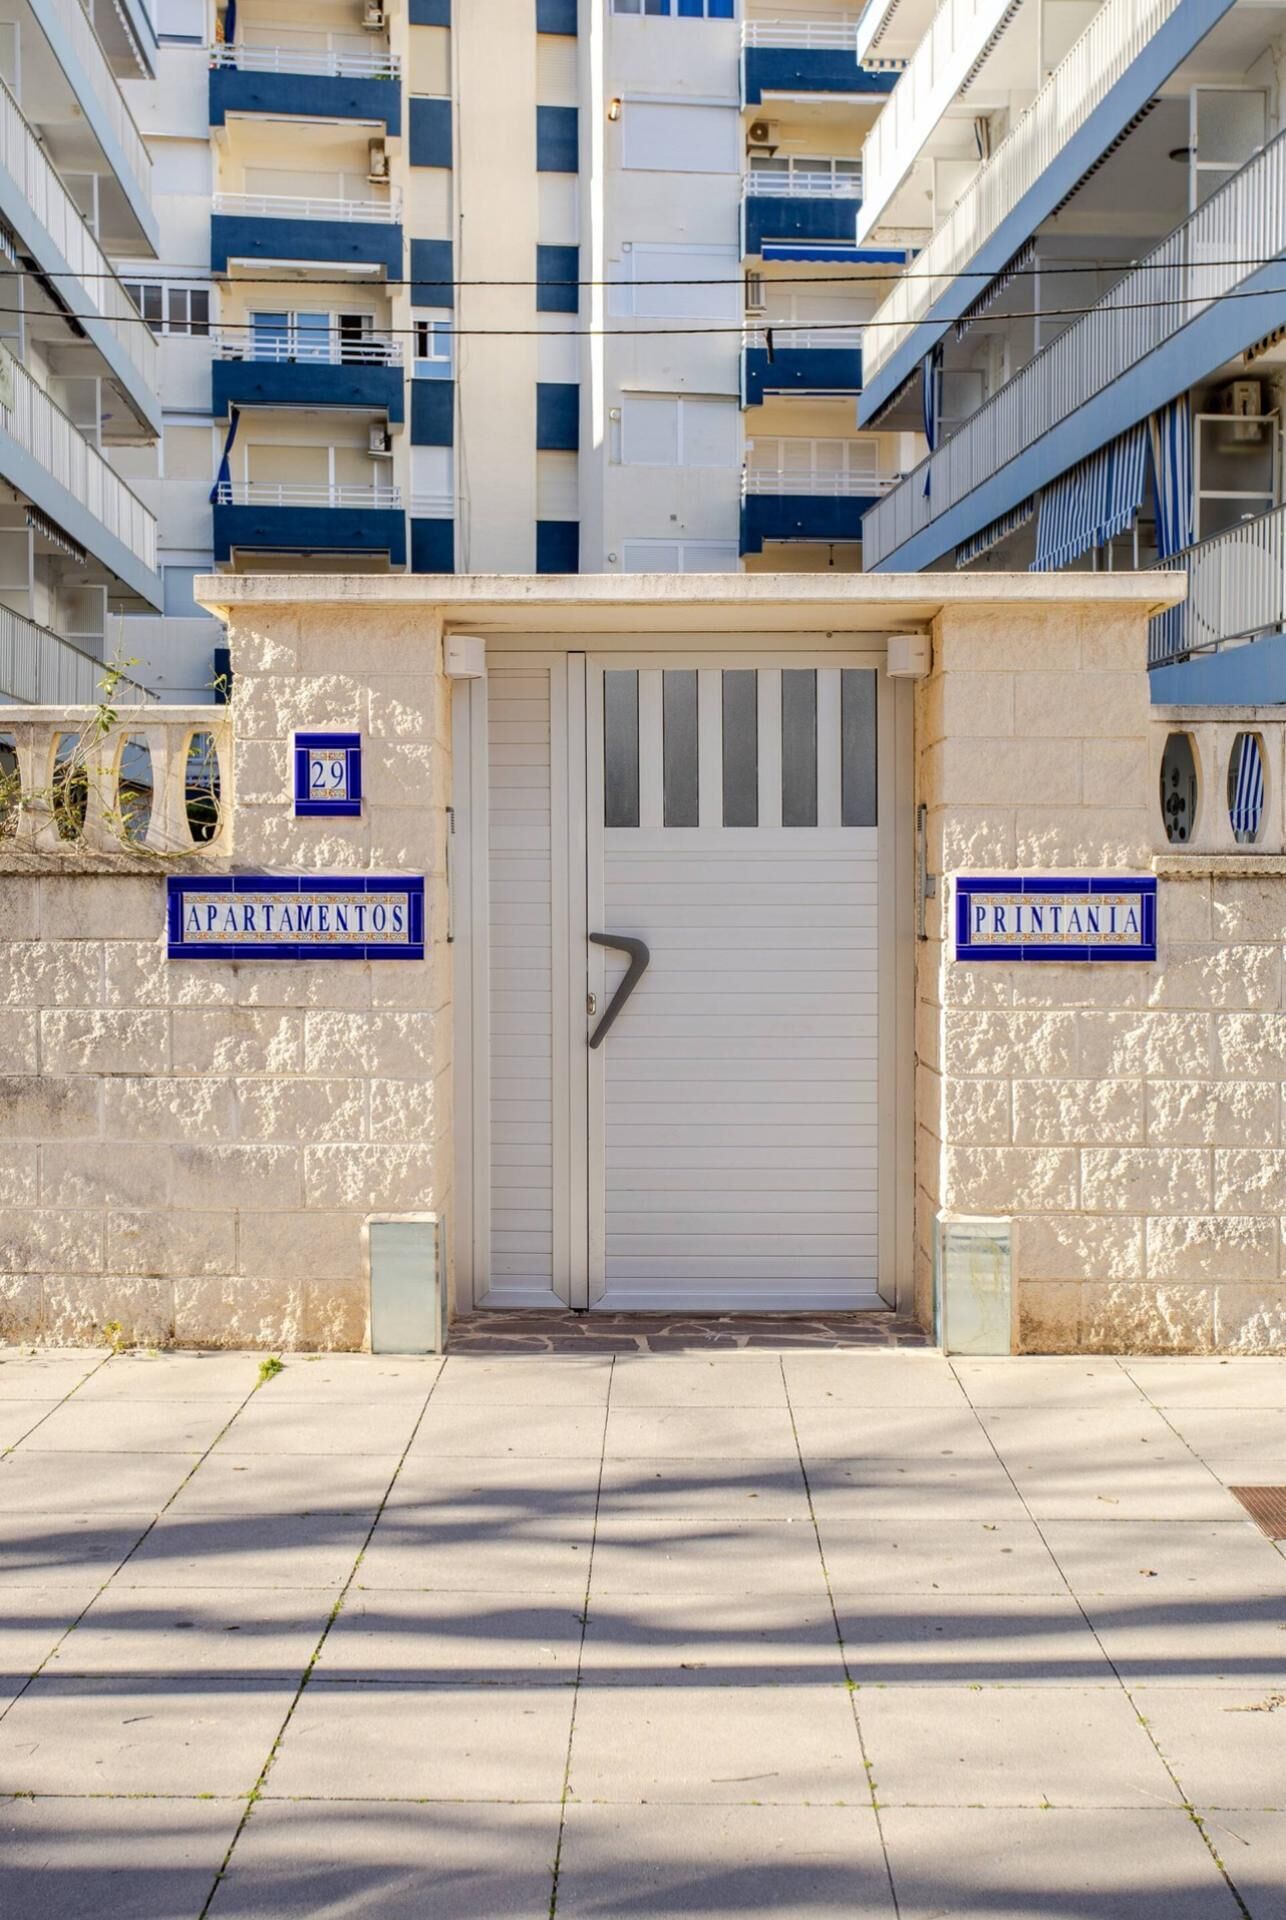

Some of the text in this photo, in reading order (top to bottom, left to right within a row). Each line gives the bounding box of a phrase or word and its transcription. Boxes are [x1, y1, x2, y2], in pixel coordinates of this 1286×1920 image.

[311, 761, 344, 789] 29
[186, 904, 403, 932] APARTAMENTOS
[975, 906, 1139, 933] PRINTANIA
